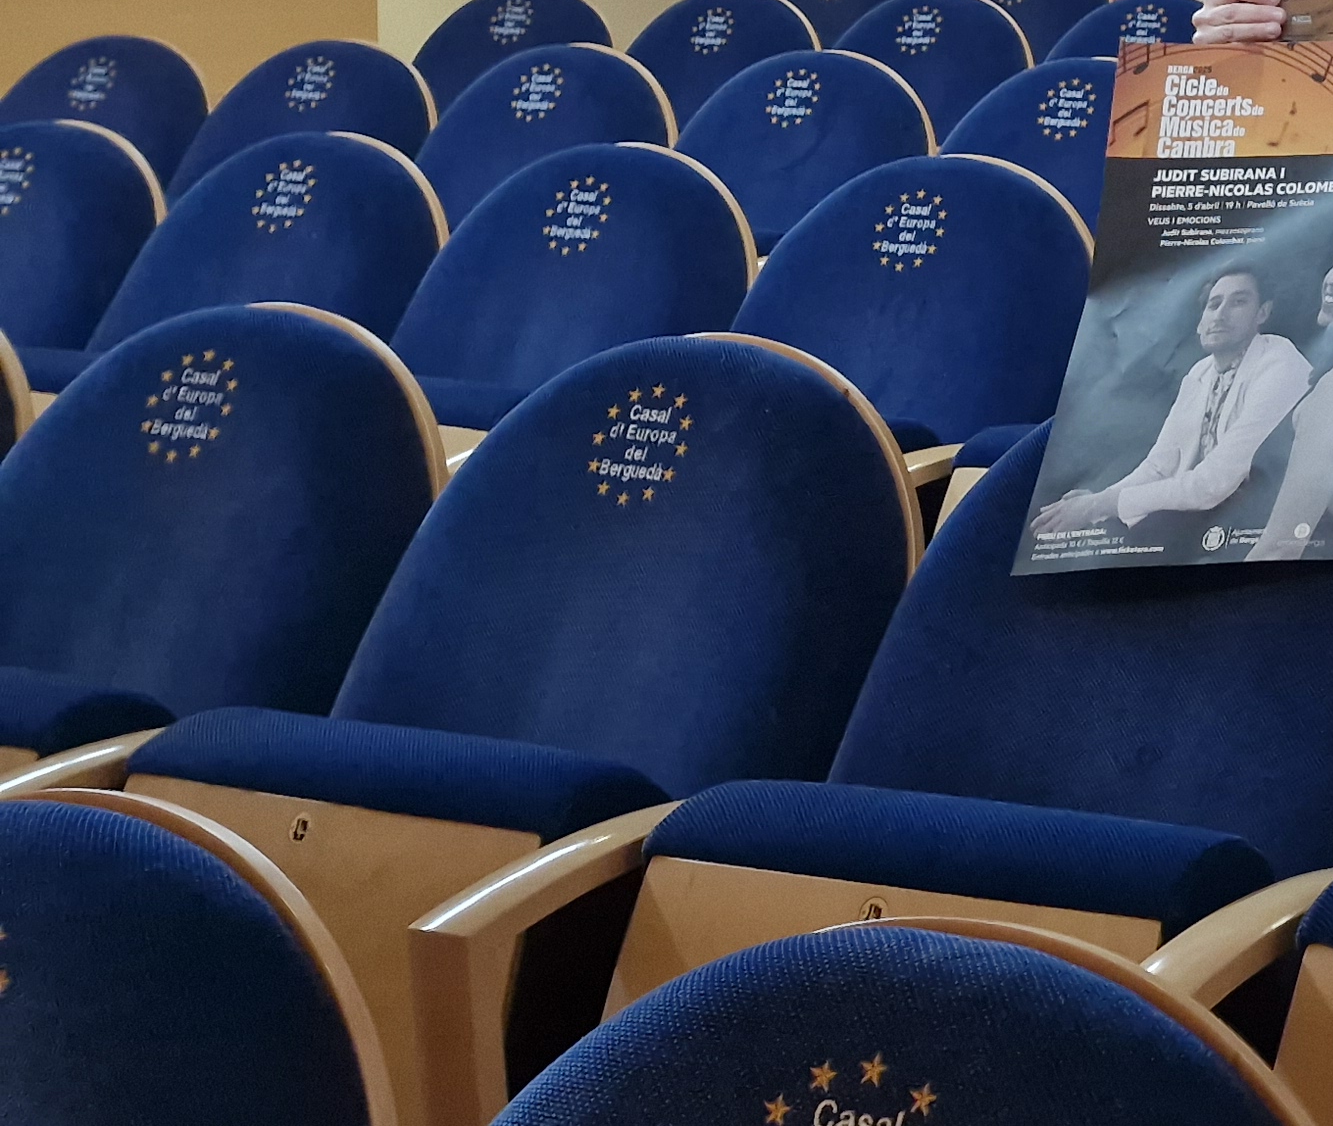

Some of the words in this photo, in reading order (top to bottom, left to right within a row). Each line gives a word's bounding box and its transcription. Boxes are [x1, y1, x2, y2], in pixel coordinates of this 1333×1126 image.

[1165, 75, 1217, 96] Cicle
[1217, 85, 1229, 96] de
[1162, 95, 1253, 117] Concerts
[1252, 105, 1264, 116] de
[1159, 115, 1234, 138] Música
[1233, 126, 1245, 137] de
[1157, 136, 1236, 158] Cambra
[1153, 170, 1198, 183] JUDIT
[1200, 168, 1277, 182] SUBIRANA
[1280, 167, 1286, 179] I
[1152, 182, 1273, 198] PIERRE-NICOLAS
[901, 203, 931, 216] Casal
[1148, 217, 1170, 226] VEUS
[1176, 216, 1222, 225] EMOCIONS
[899, 230, 916, 242] del
[881, 241, 927, 256] Berguedà
[181, 368, 221, 386] Casal
[174, 406, 197, 422] del
[630, 405, 672, 424] Casal
[150, 419, 208, 440] Berguedà
[626, 424, 677, 446] Europa
[624, 445, 648, 461] del
[600, 459, 662, 482] Berguedà
